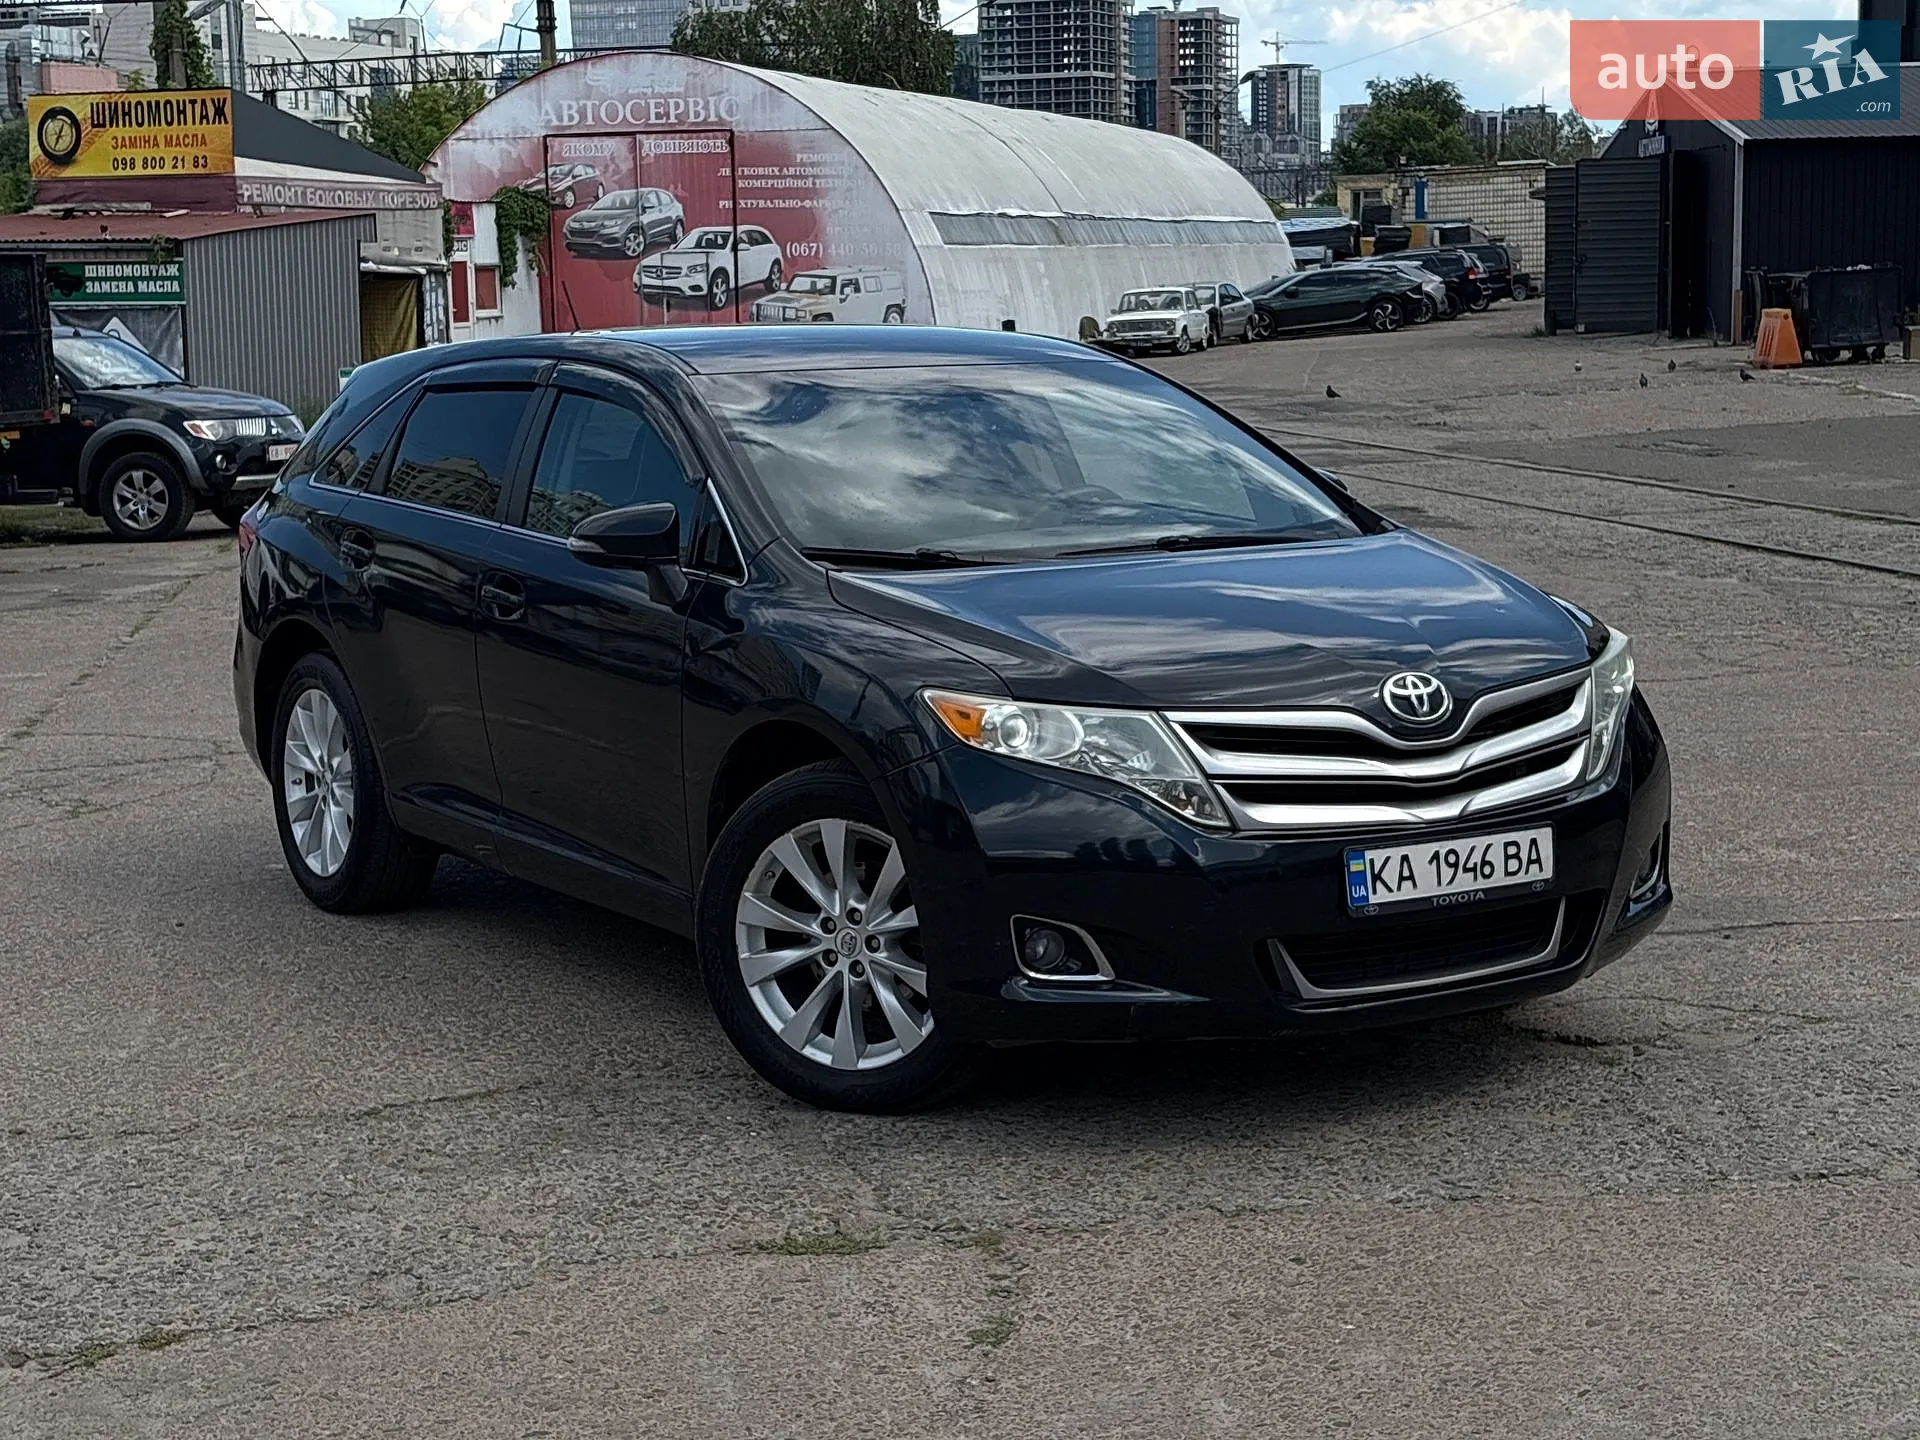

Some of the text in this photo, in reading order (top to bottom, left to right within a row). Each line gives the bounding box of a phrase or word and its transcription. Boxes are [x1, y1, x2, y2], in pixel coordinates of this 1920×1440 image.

[89, 97, 229, 129] ШИНОМОНТАЖ
[536, 95, 741, 126] АВТОСЕРВІС
[111, 133, 208, 150] ЗАМІНА МАСЛА
[562, 139, 729, 157] ЯКОМУ ДОВІРЯЮТЬ
[112, 155, 208, 171] 098 800 21 83
[241, 183, 439, 209] РЕМОНТ БОКОВЫХ ПОРЕЗОВ
[786, 241, 823, 258] (067)
[84, 263, 180, 278] ШИНОМОНТАЖ
[86, 280, 180, 293] ЗАМЕНА МАСЛА
[1368, 837, 1544, 896] KA 1946 BA
[1351, 884, 1367, 898] UA
[1432, 890, 1486, 907] TOYOTA
